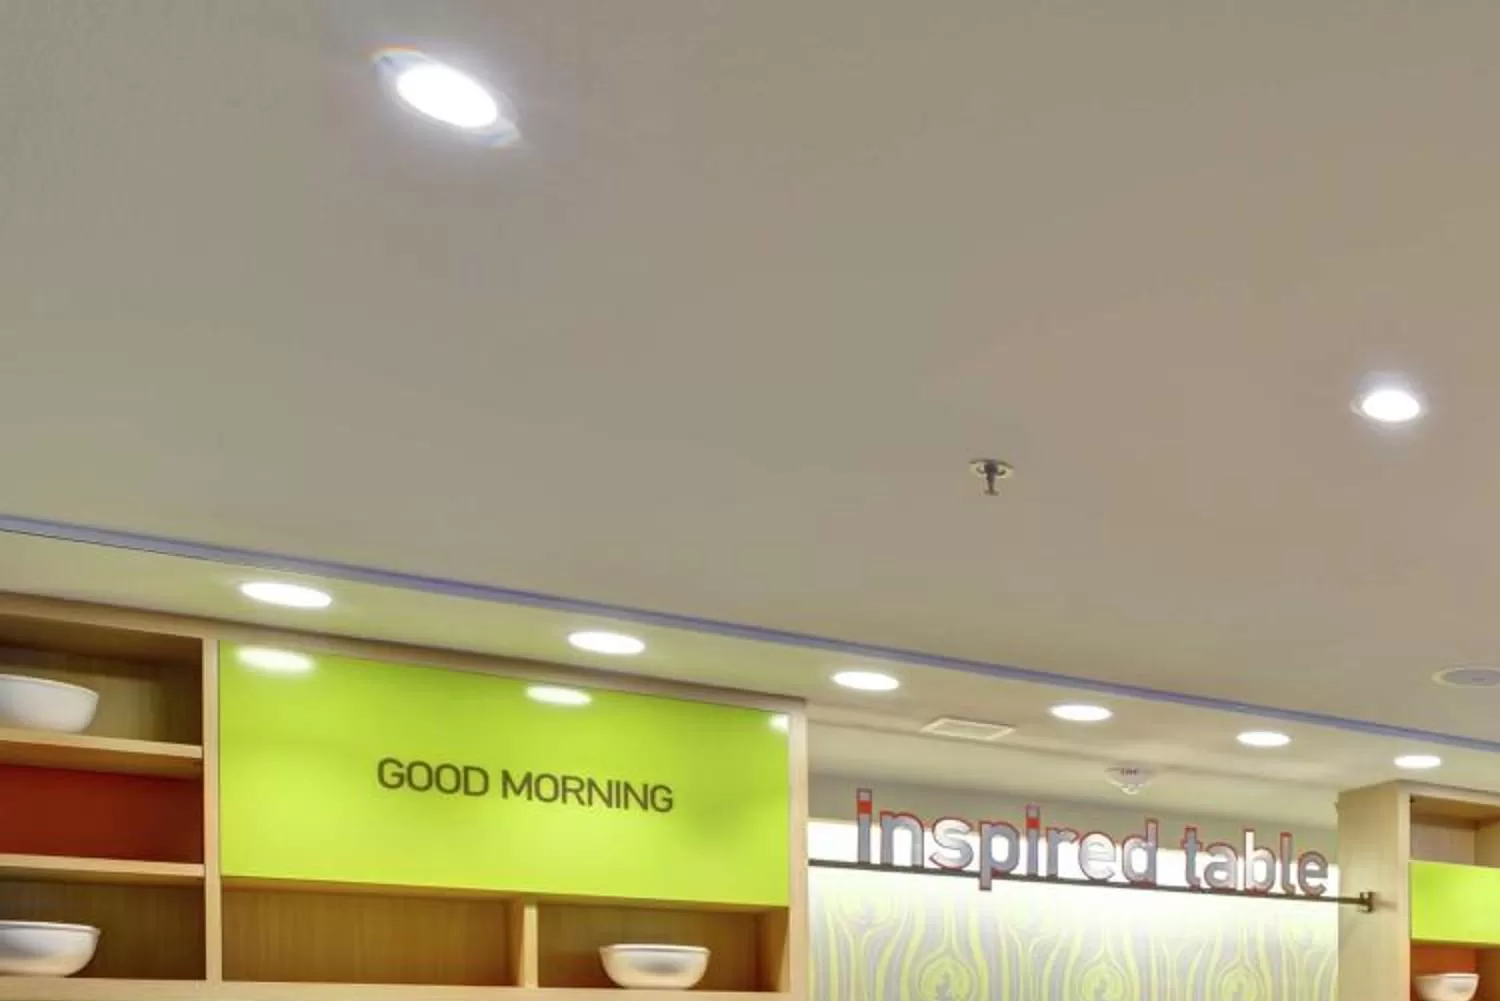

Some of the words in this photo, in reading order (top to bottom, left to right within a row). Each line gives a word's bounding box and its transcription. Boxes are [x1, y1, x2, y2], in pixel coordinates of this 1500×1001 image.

[377, 757, 490, 797] GOOD
[500, 768, 674, 813] MORNING
[856, 787, 1158, 892] inspired
[1183, 825, 1330, 897] table
